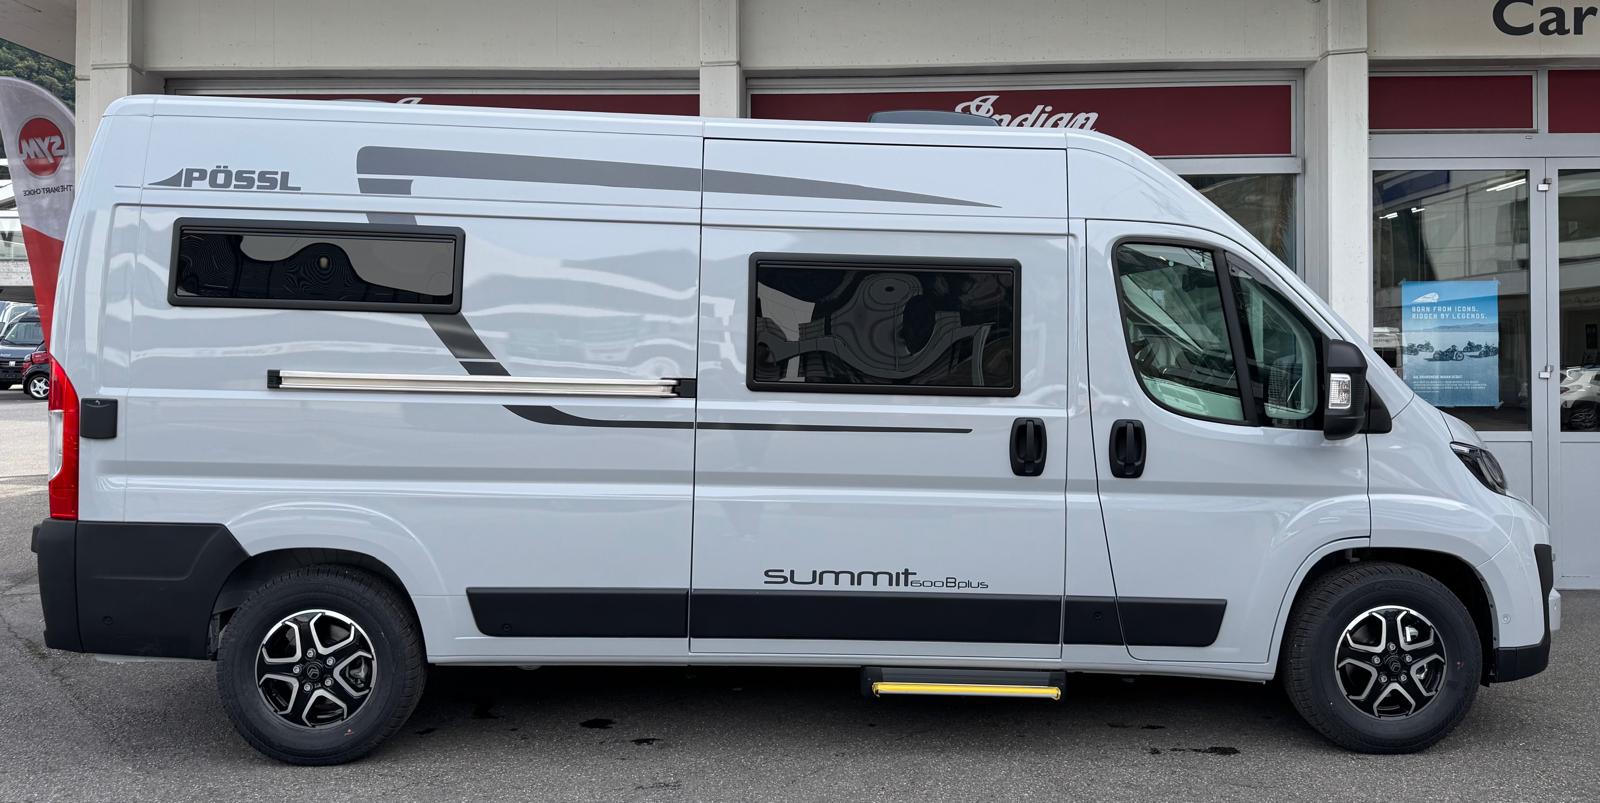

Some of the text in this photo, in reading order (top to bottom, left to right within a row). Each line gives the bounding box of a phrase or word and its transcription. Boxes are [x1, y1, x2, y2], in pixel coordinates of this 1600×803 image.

[1493, 0, 1598, 36] Car
[954, 95, 1099, 131] Indian
[183, 165, 301, 192] PÖSSL
[1411, 312, 1488, 320] RIDDEN BY LEGENDS.
[763, 568, 917, 587] summit
